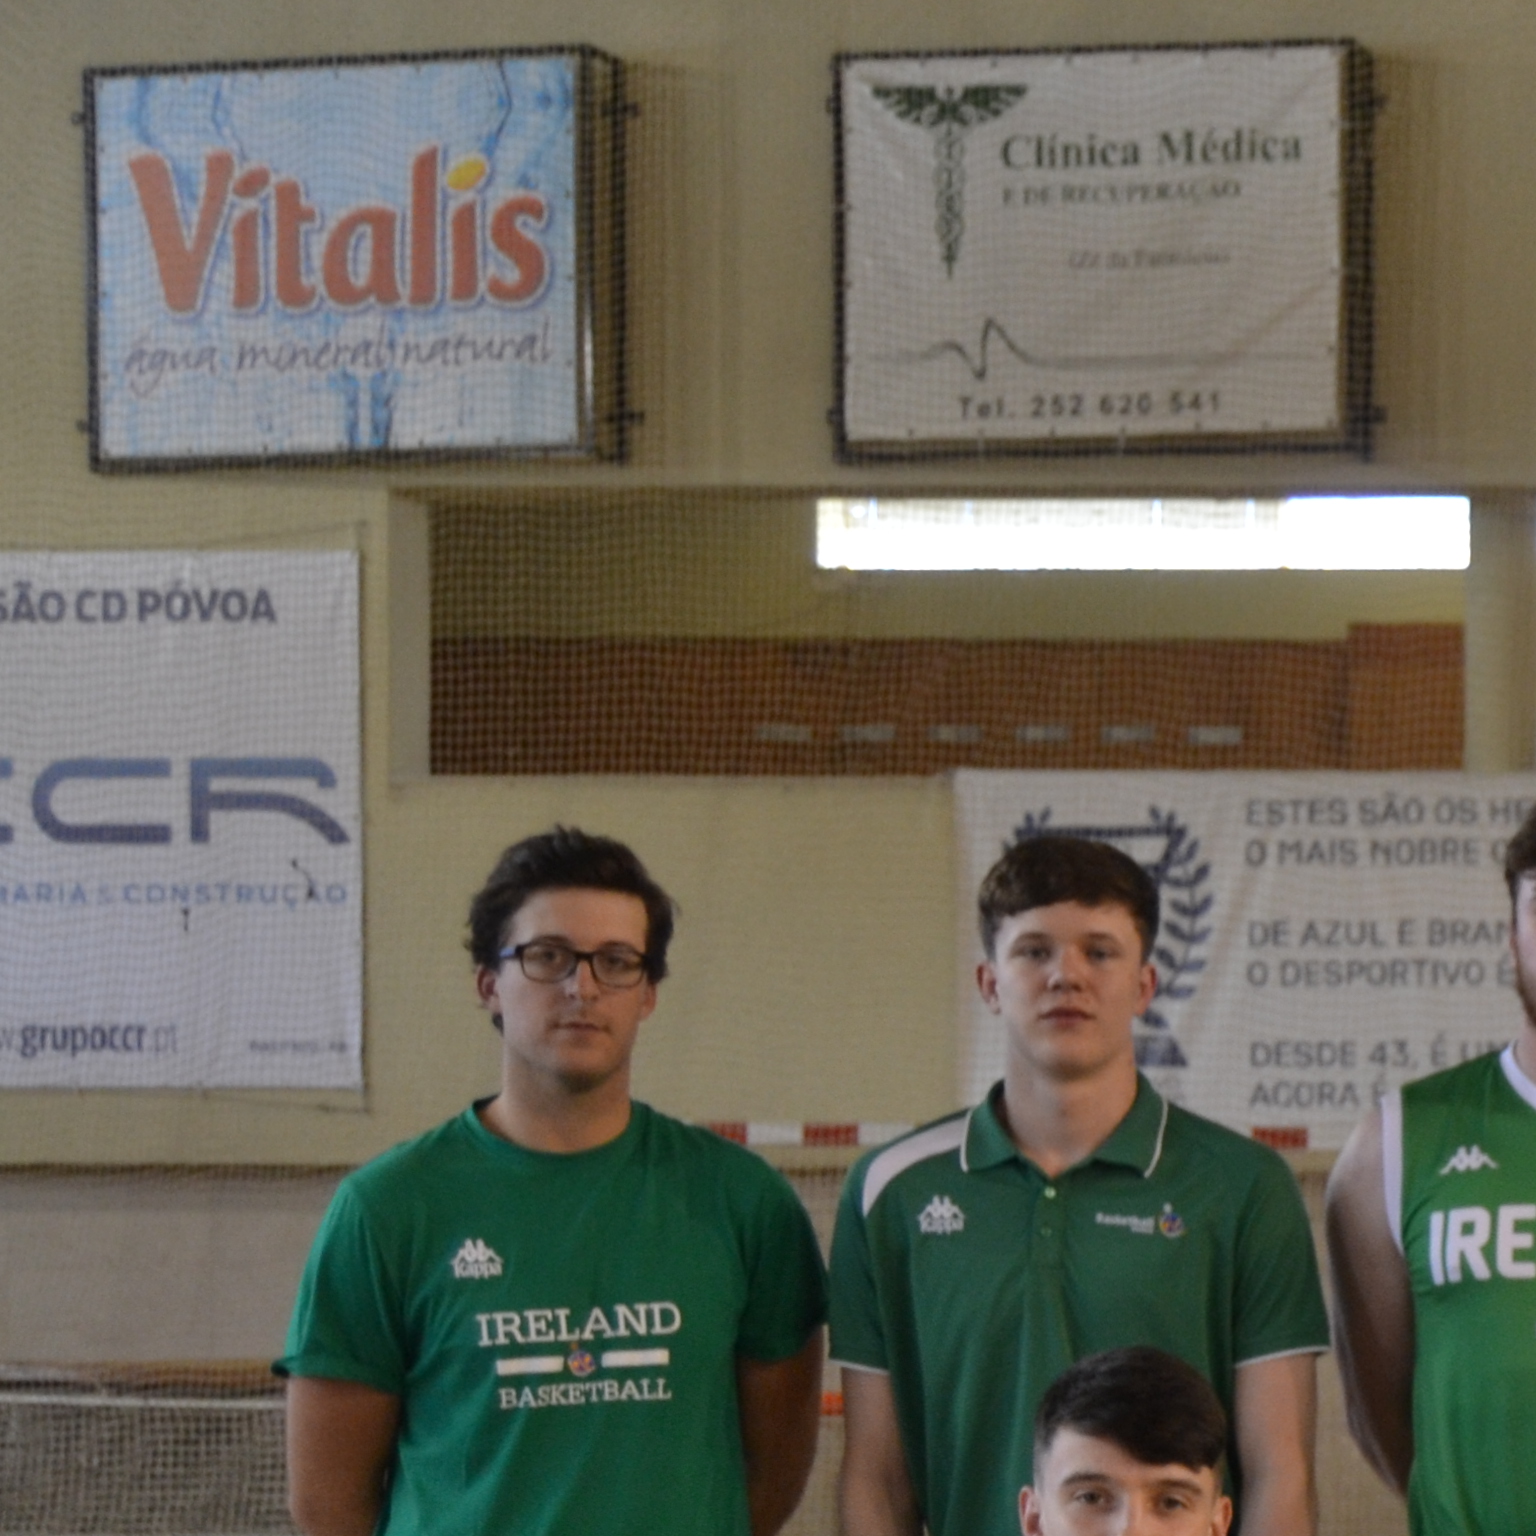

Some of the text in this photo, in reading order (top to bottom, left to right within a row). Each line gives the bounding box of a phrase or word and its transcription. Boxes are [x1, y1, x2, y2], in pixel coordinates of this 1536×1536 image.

[1000, 128, 1302, 170] Clínica Médica
[128, 145, 548, 313] Vitalis
[124, 322, 552, 395] água mineral natural
[959, 389, 1220, 419] Tel. 252 620 541
[75, 589, 127, 623] CD
[137, 578, 278, 624] PÓVOA
[0, 757, 351, 845] CR
[1245, 798, 1348, 826] ESTES
[1358, 791, 1424, 825] SÃO
[1433, 797, 1480, 825] OS
[1245, 839, 1267, 867] O
[1277, 839, 1359, 866] MAIS
[1369, 838, 1480, 865] NOBRE
[122, 880, 348, 911] CONSTRUÇÃO
[1248, 921, 1290, 948] DE
[1300, 921, 1383, 948] AZUL
[1397, 921, 1417, 946] E
[1427, 919, 1512, 947] BRAN
[1247, 961, 1269, 988] O
[1279, 959, 1485, 988] DESPORTIVO
[1250, 1041, 1356, 1069] DESDE
[1250, 1080, 1359, 1109] AGORA
[475, 1302, 682, 1347] IRELAND
[499, 1377, 672, 1410] BASKETBALL
